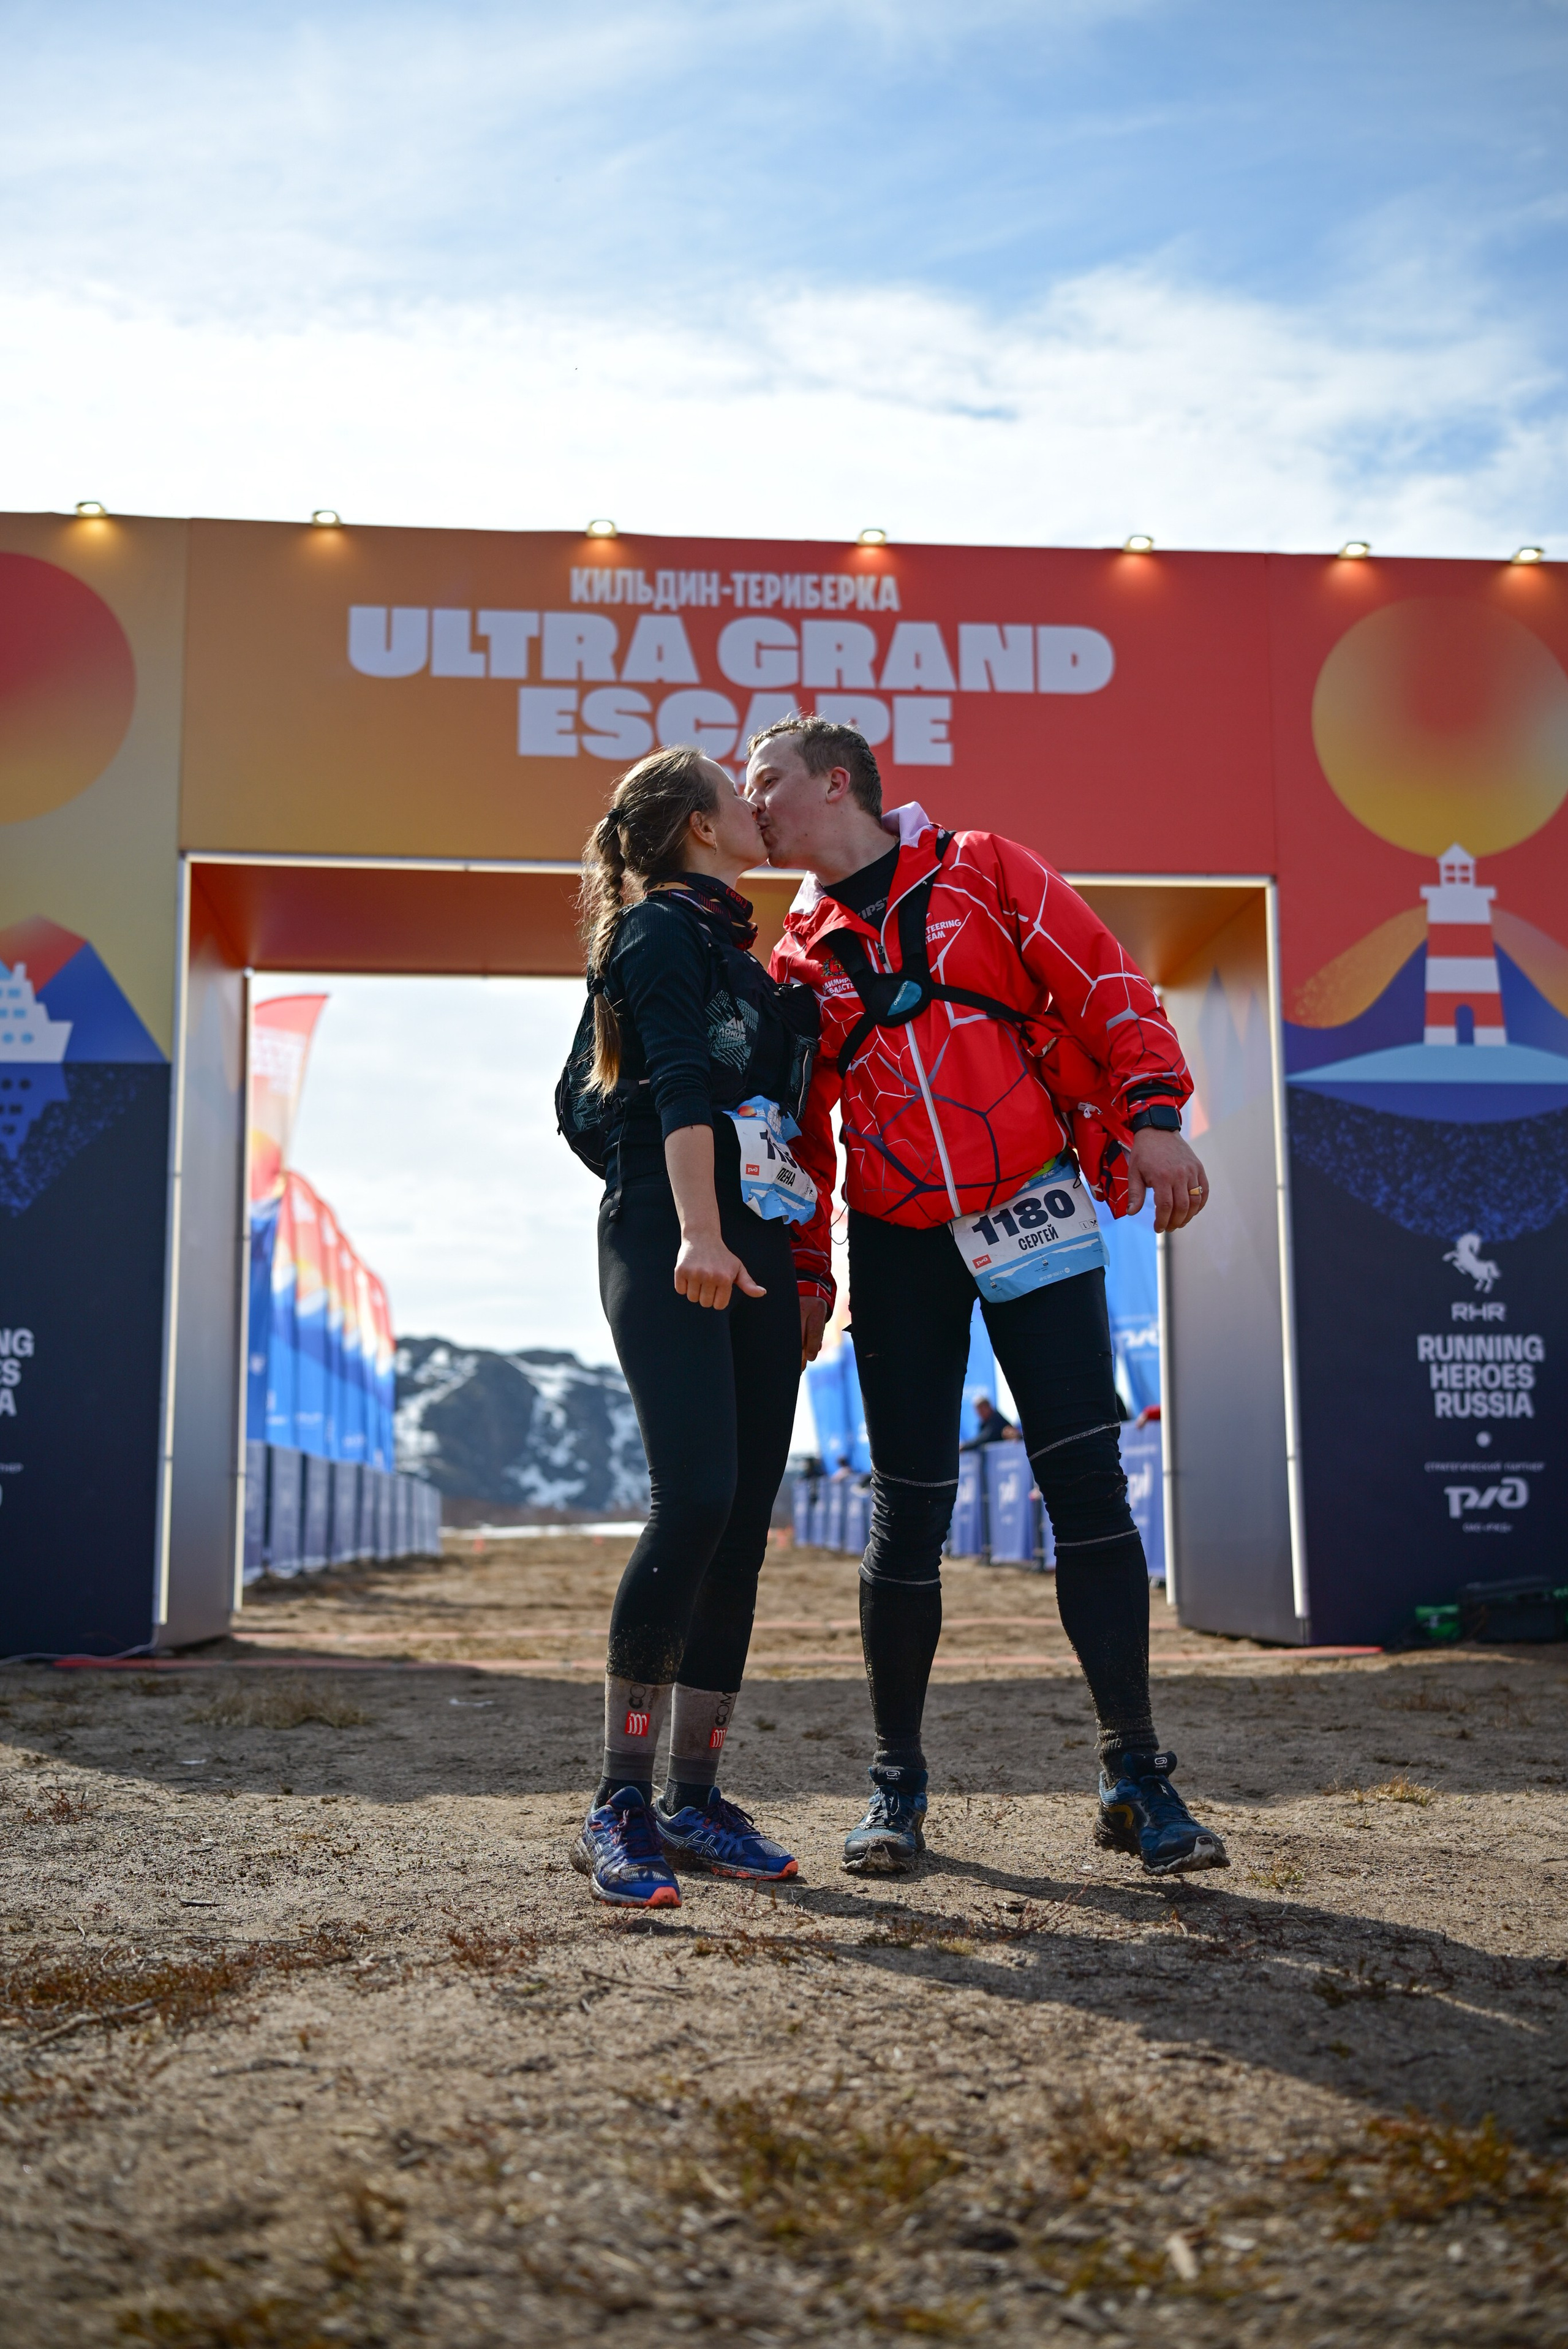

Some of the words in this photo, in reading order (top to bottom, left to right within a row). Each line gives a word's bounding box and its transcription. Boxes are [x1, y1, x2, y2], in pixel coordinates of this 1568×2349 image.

[570, 567, 900, 611] КИЛЬДИН-ТЕРИБЕРКА
[347, 605, 701, 684] ULTRA
[717, 616, 1115, 695] GRAND
[925, 930, 946, 945] EAM
[971, 1189, 1075, 1246] 1180
[1018, 1224, 1059, 1250] СЕРГЕЙ
[1451, 1302, 1506, 1322] RHR
[1417, 1334, 1545, 1363] RUNNING
[1430, 1363, 1536, 1390] HEROES
[1434, 1391, 1534, 1418] RUSSIA
